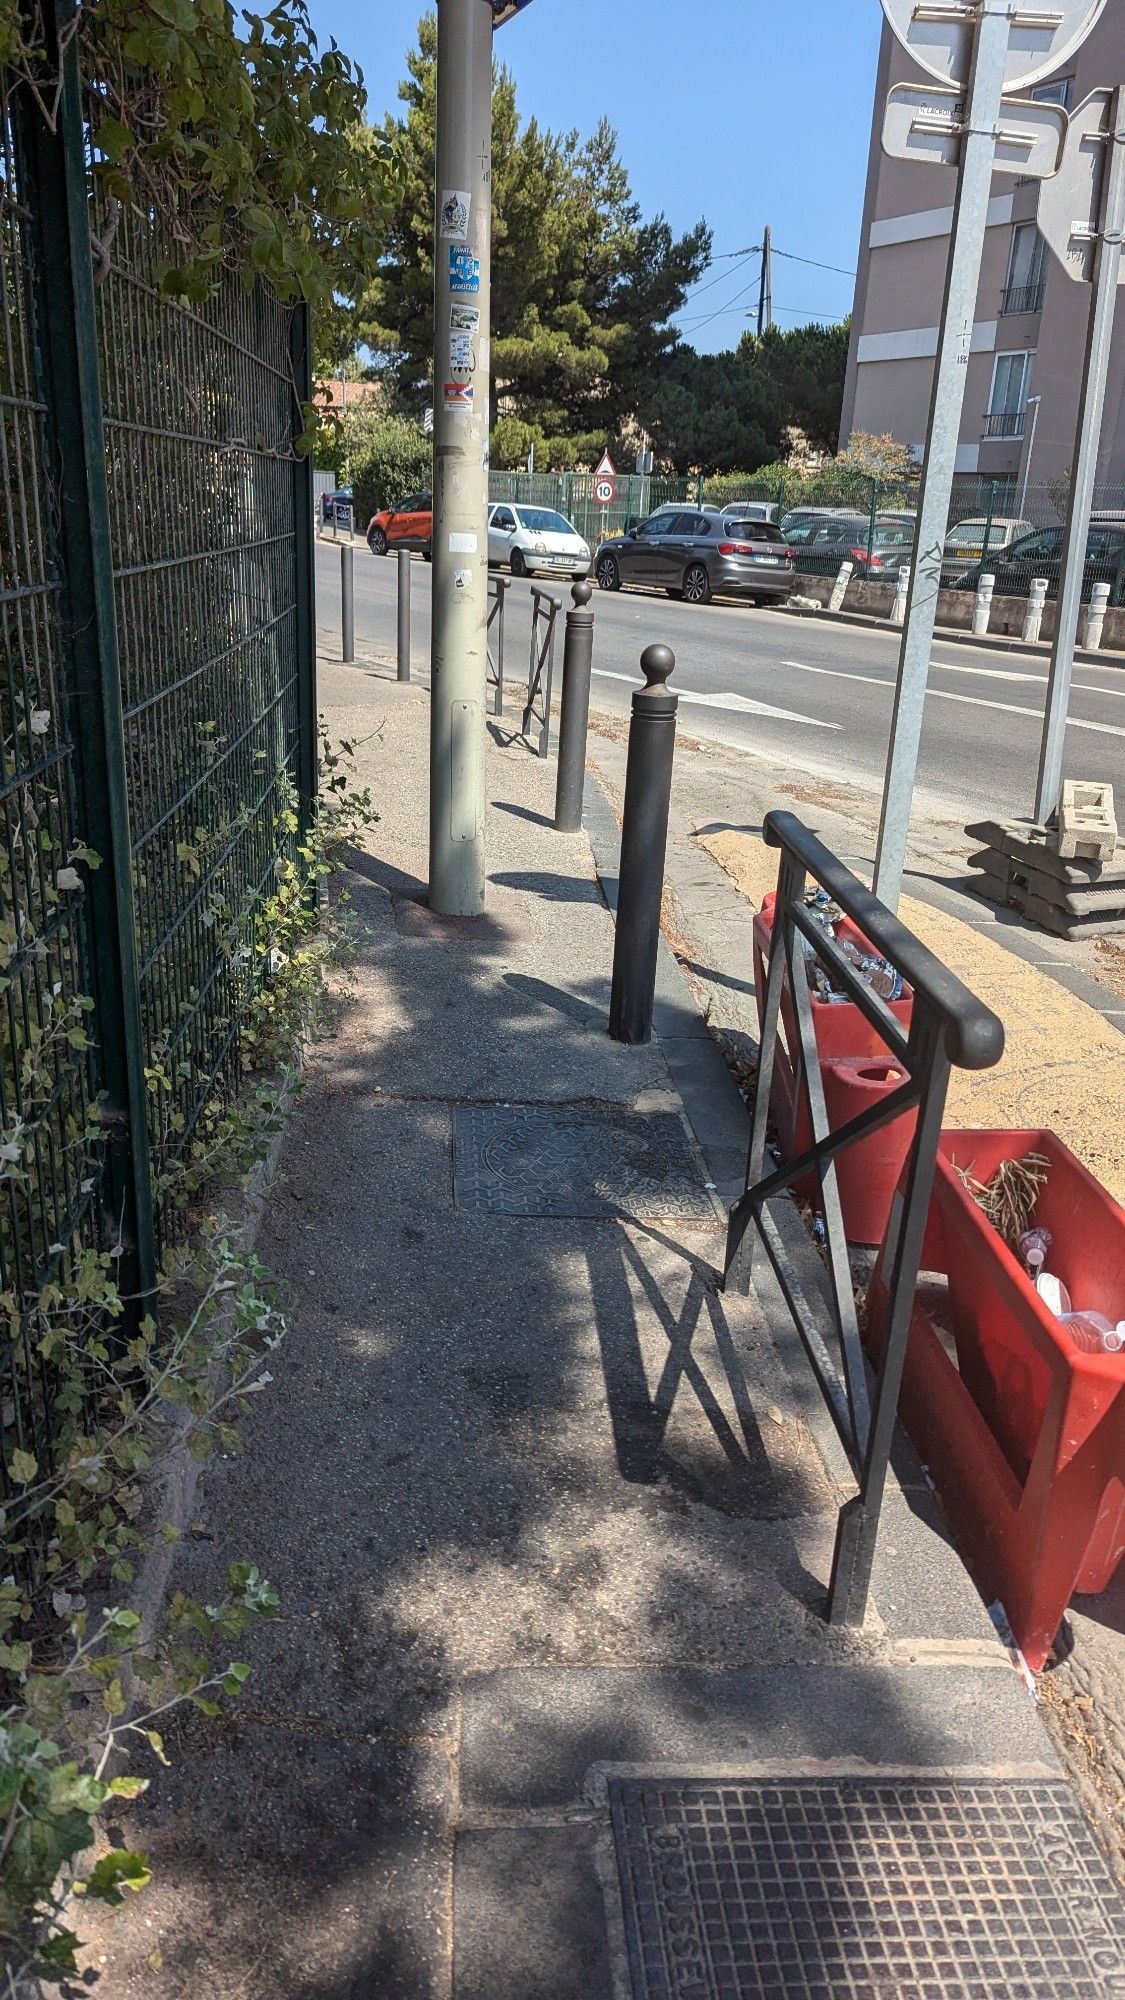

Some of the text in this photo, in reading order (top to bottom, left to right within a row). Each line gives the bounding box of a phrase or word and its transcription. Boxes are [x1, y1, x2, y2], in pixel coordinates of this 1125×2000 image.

[927, 107, 954, 116] LACROIX
[599, 486, 611, 497] 10
[1040, 1832, 1093, 1910] ACIER
